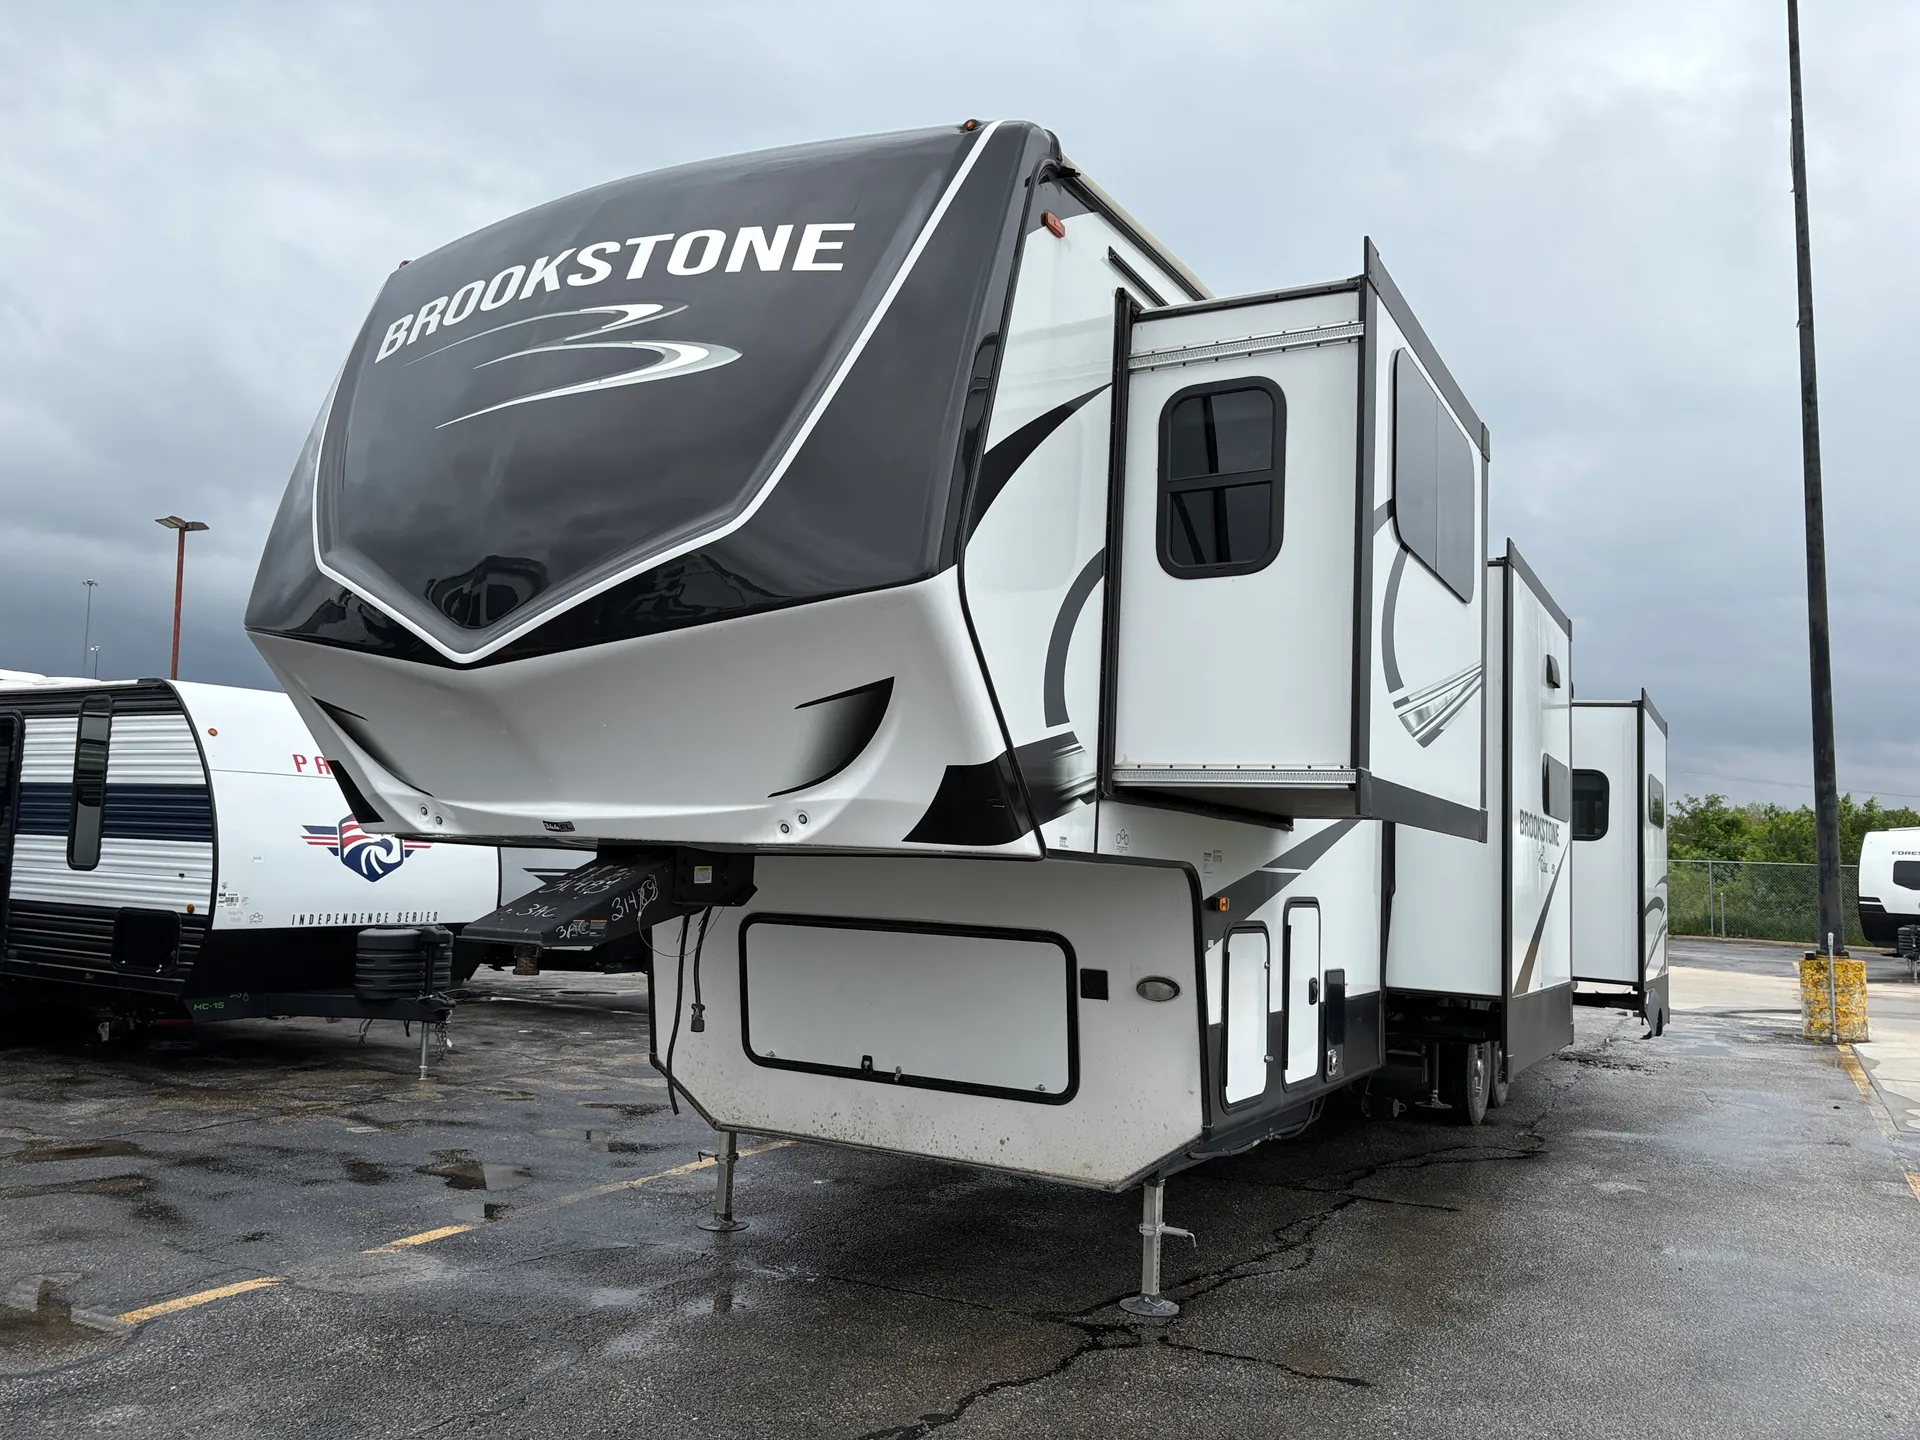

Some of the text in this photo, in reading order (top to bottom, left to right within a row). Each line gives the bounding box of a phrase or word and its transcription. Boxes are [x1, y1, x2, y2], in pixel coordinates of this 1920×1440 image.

[375, 222, 856, 364] BROOKSTONE
[1519, 808, 1560, 847] BROOKSTONE
[291, 911, 439, 926] INDEPENDENCE SERIES
